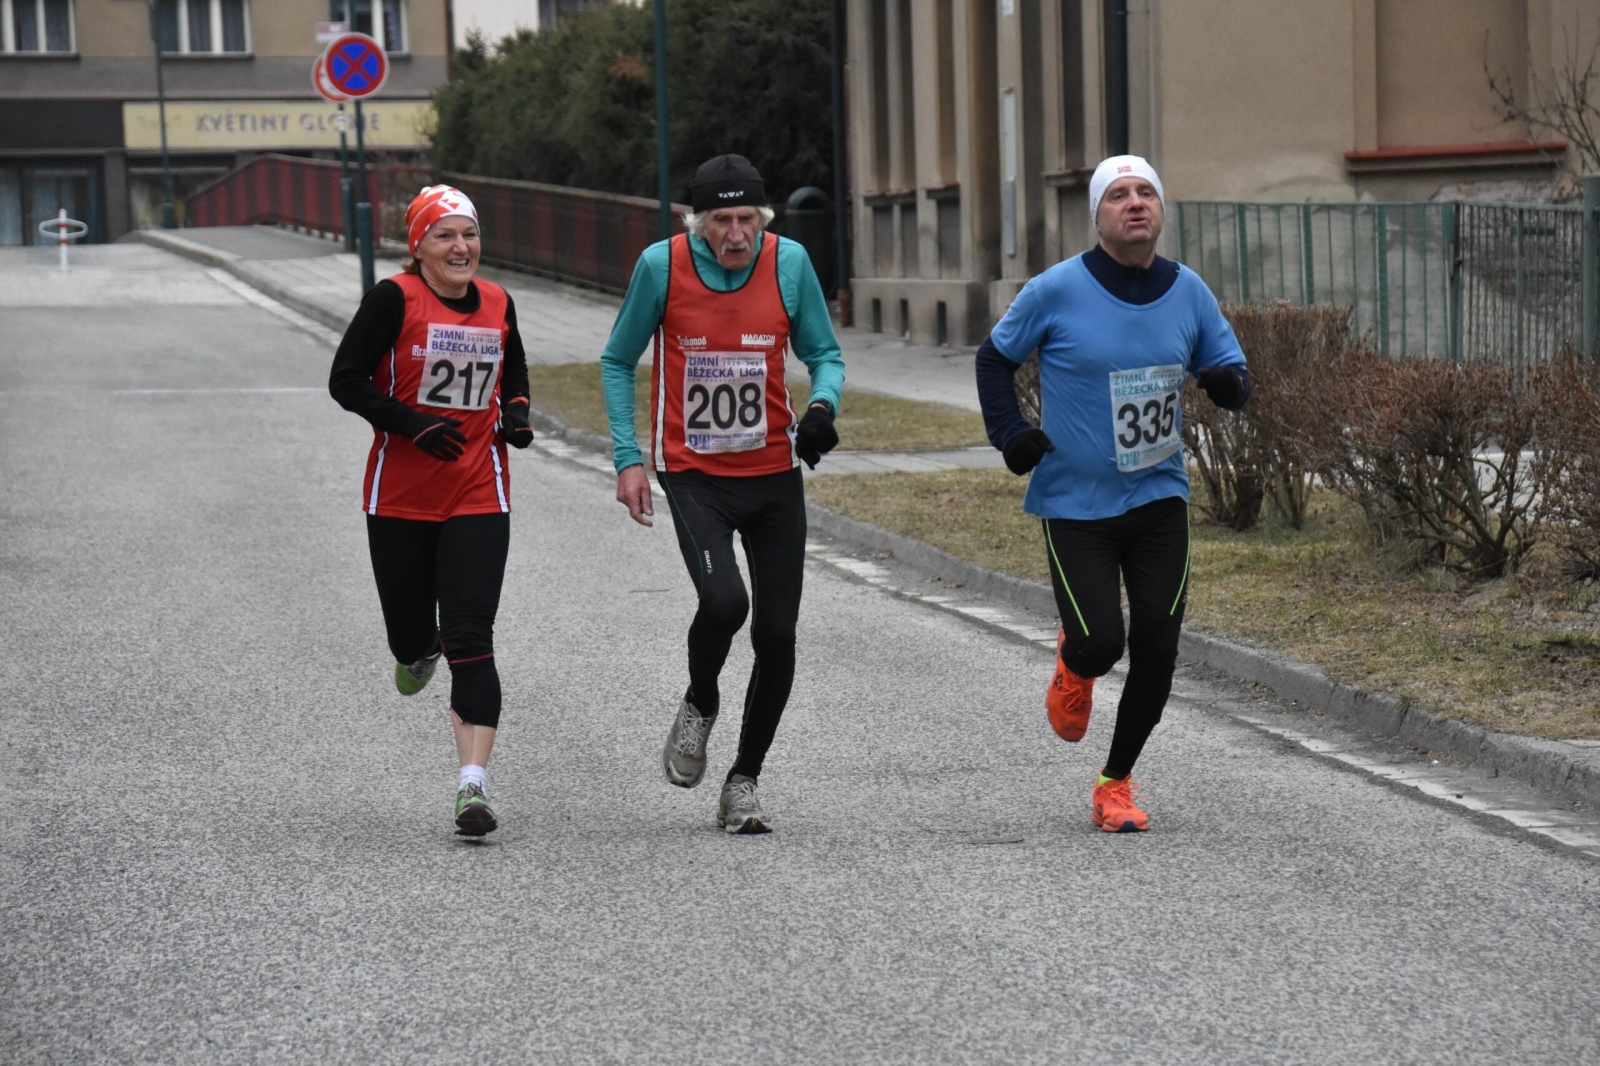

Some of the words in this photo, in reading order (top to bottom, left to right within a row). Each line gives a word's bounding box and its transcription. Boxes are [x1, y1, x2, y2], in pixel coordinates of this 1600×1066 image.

[196, 109, 289, 133] KVĚTINY
[433, 329, 465, 341] ZIMNÍ
[741, 333, 776, 341] MARATON
[432, 340, 477, 354] BĚŽECKÁ
[481, 345, 499, 356] LIGA
[688, 355, 719, 366] ZIMNÍ
[687, 367, 734, 378] BĚŽECKÁ
[739, 367, 764, 377] LIGA
[1114, 372, 1146, 385] ZIMNÍ
[426, 359, 494, 407] 217
[1114, 382, 1161, 397] BĚŽECKÁ
[687, 382, 762, 429] 208
[1118, 392, 1177, 449] 335
